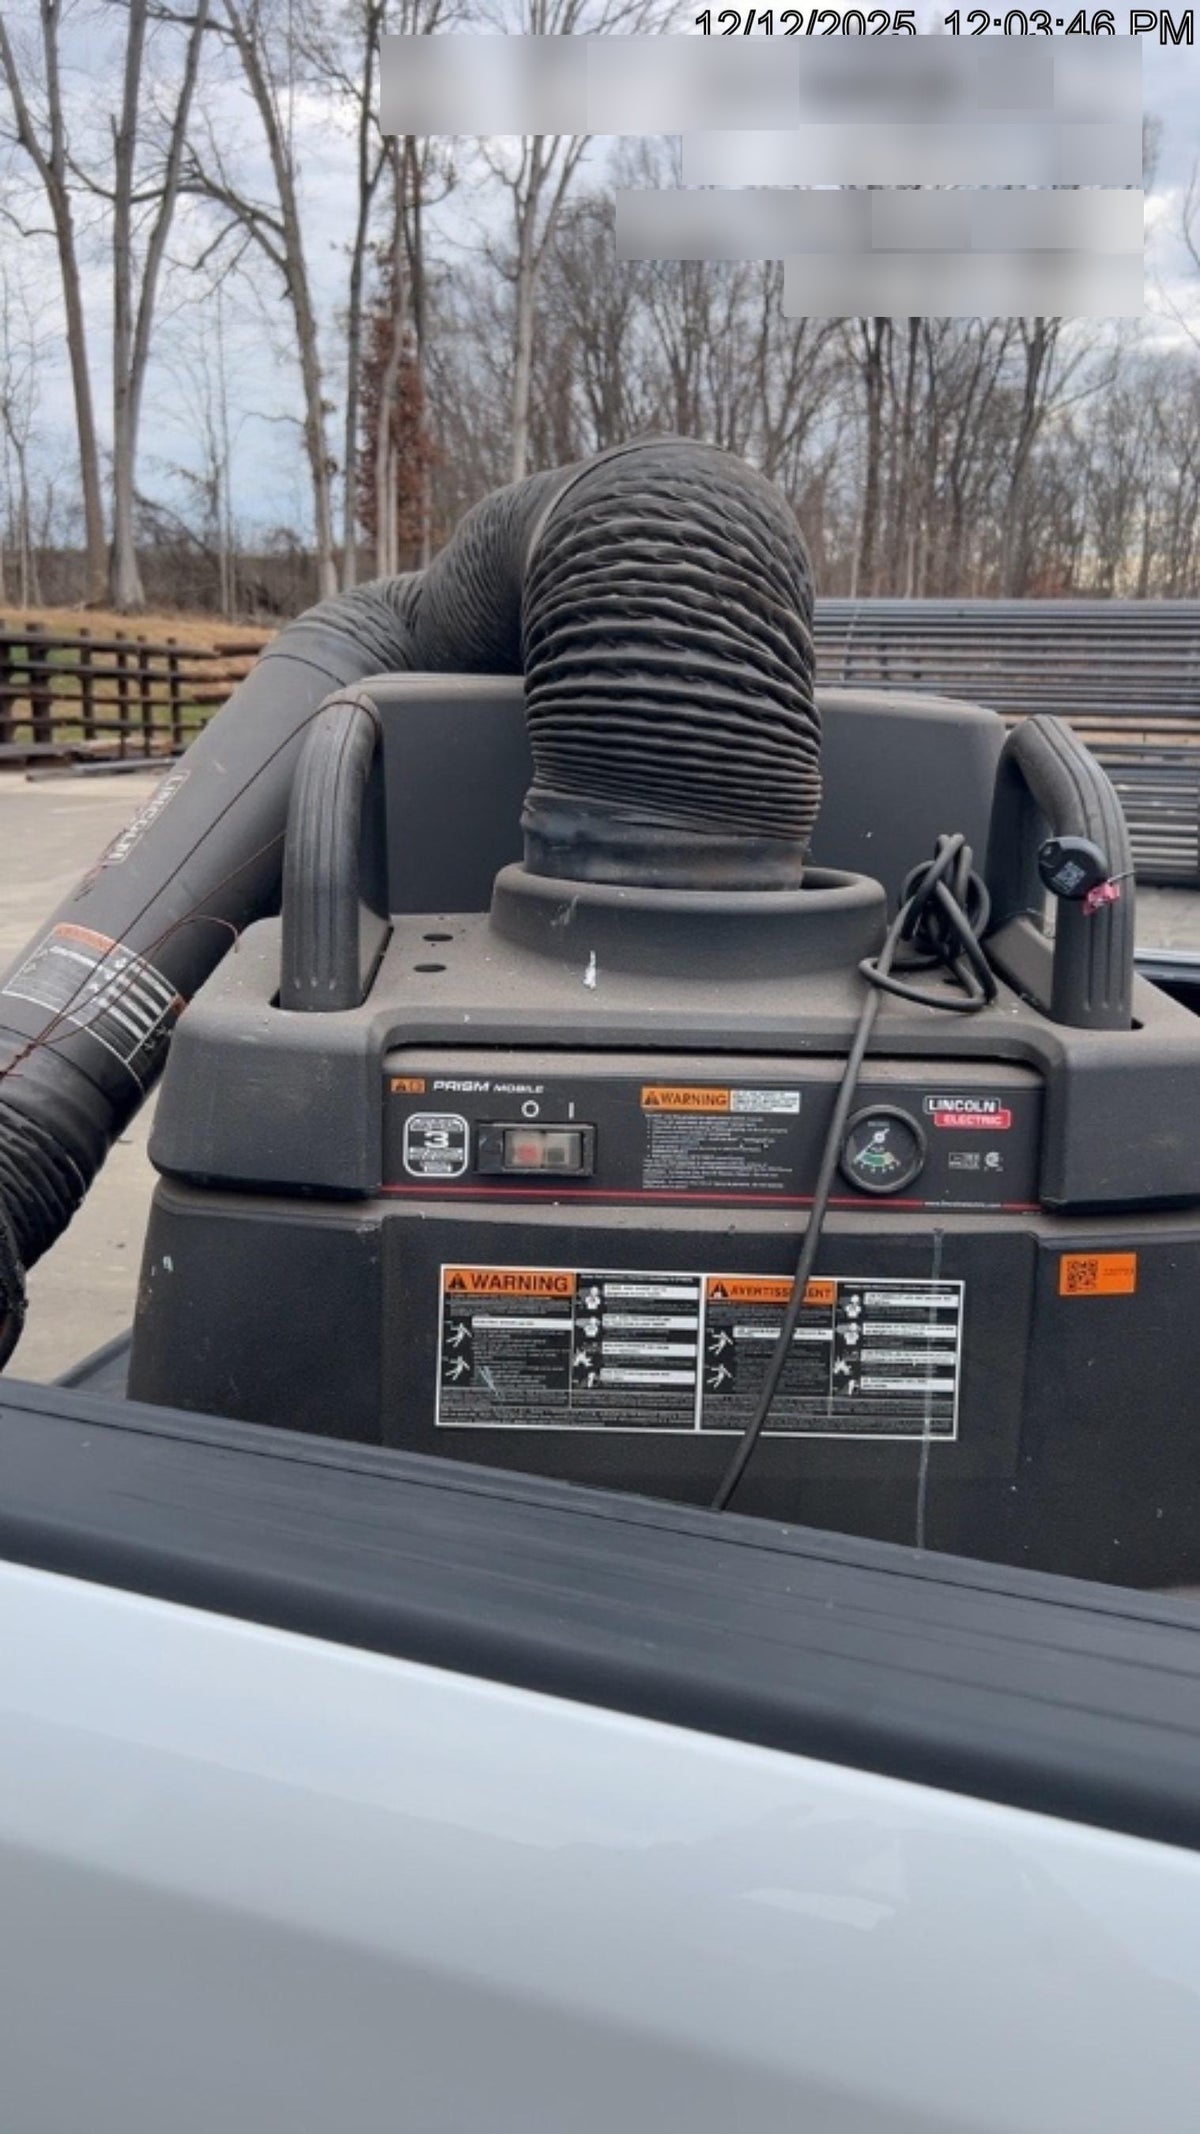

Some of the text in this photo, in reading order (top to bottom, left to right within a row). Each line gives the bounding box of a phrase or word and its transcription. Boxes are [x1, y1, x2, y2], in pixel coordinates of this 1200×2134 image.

[433, 1080, 545, 1094] PRISM MOBILE
[660, 1091, 727, 1107] WARNING
[928, 1099, 995, 1113] LINCOLN
[943, 1114, 1002, 1125] ELECTRIC
[424, 1131, 449, 1148] 3
[471, 1273, 568, 1292] WARNING
[730, 1284, 832, 1298] AVERTISSENT
